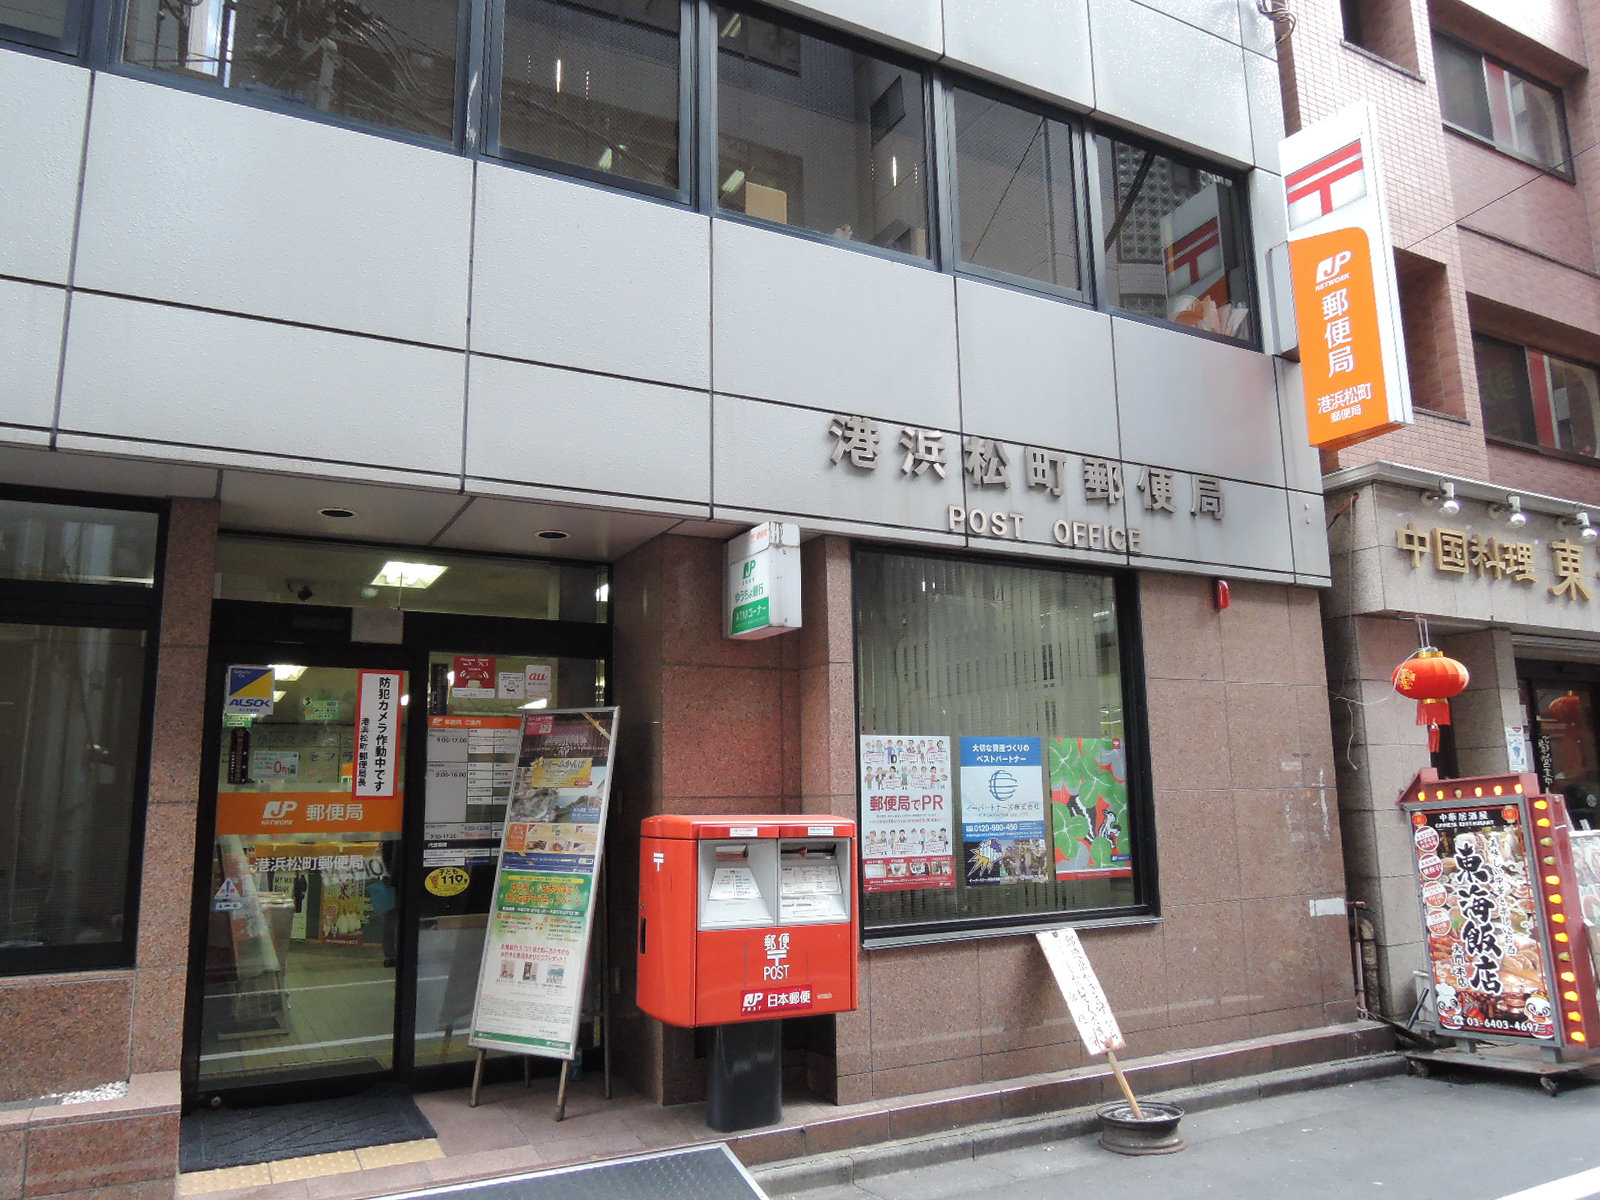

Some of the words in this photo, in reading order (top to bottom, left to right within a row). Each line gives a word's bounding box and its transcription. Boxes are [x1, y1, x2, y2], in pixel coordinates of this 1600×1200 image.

[1315, 272, 1350, 292] NETWORK
[1322, 287, 1354, 378] 郵便局
[1317, 382, 1372, 414] 港浜松町
[1330, 404, 1362, 424] 郵便局
[829, 416, 1225, 520] 港浜松町郵便局
[948, 504, 1024, 540] POST
[1053, 519, 1142, 553] OFFICE
[1396, 522, 1540, 583] 中国料理
[1547, 538, 1600, 601] 東
[529, 673, 547, 681] au
[229, 698, 271, 707] ALSOK
[374, 677, 392, 792] 防犯カメラ作動中です
[357, 717, 370, 787] 港浜松町郵便局長
[972, 743, 1030, 753] 大切な資産づくりの
[977, 755, 1027, 763] ベストパートナー
[869, 794, 944, 812] 郵便局でPR
[306, 804, 364, 822] 郵便局
[1439, 811, 1488, 822] 中華居酒屋
[255, 854, 364, 872] 港浜松町郵便局
[1455, 842, 1502, 994] 東海飯店
[764, 933, 790, 950] 郵便
[764, 965, 789, 981] POST
[767, 990, 811, 1008] 日本郵便
[1467, 1017, 1540, 1032] 03-6403-4697
